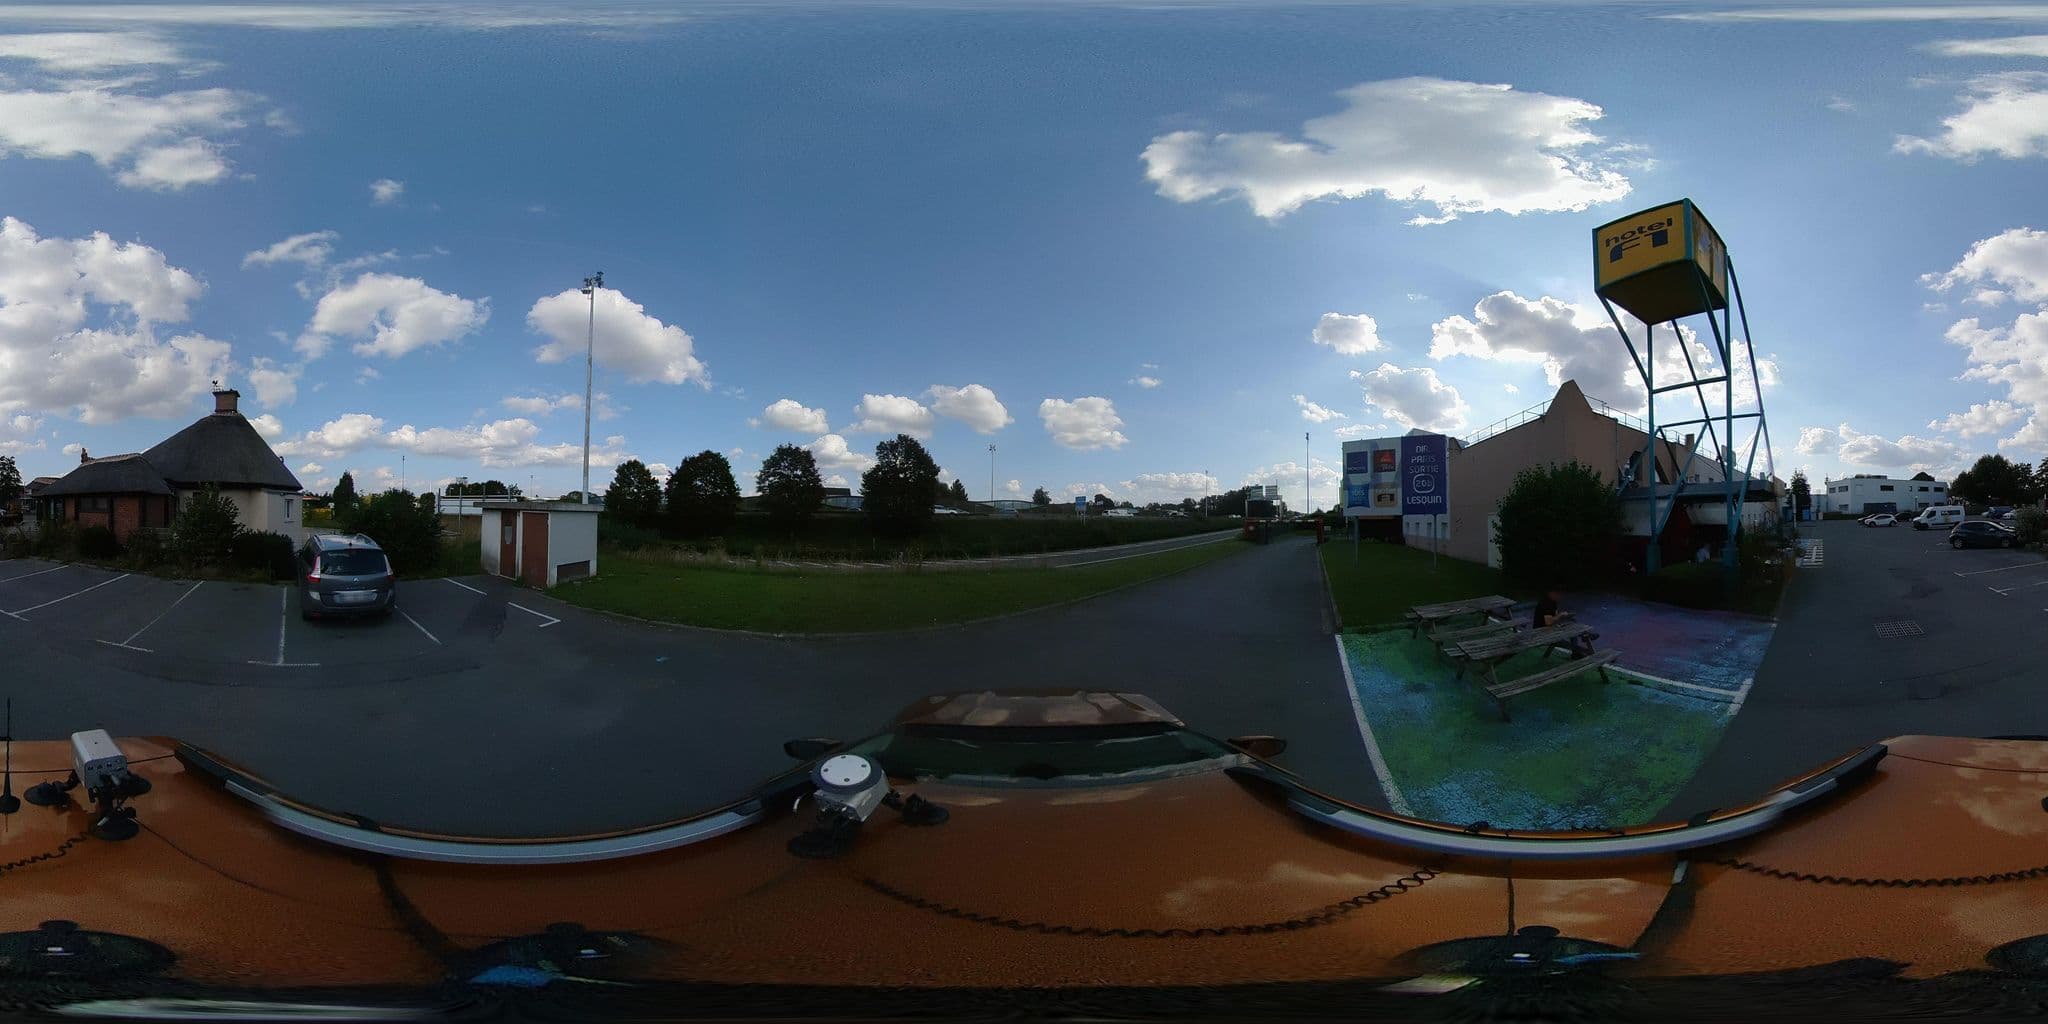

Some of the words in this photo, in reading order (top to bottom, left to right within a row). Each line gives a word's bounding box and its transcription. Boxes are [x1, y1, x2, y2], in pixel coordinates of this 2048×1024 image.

[1605, 217, 1673, 247] hotel
[1609, 229, 1669, 263] F1
[1411, 456, 1436, 464] PARIS
[1410, 464, 1439, 473] SORTIE
[1407, 495, 1442, 505] LESQUIN
